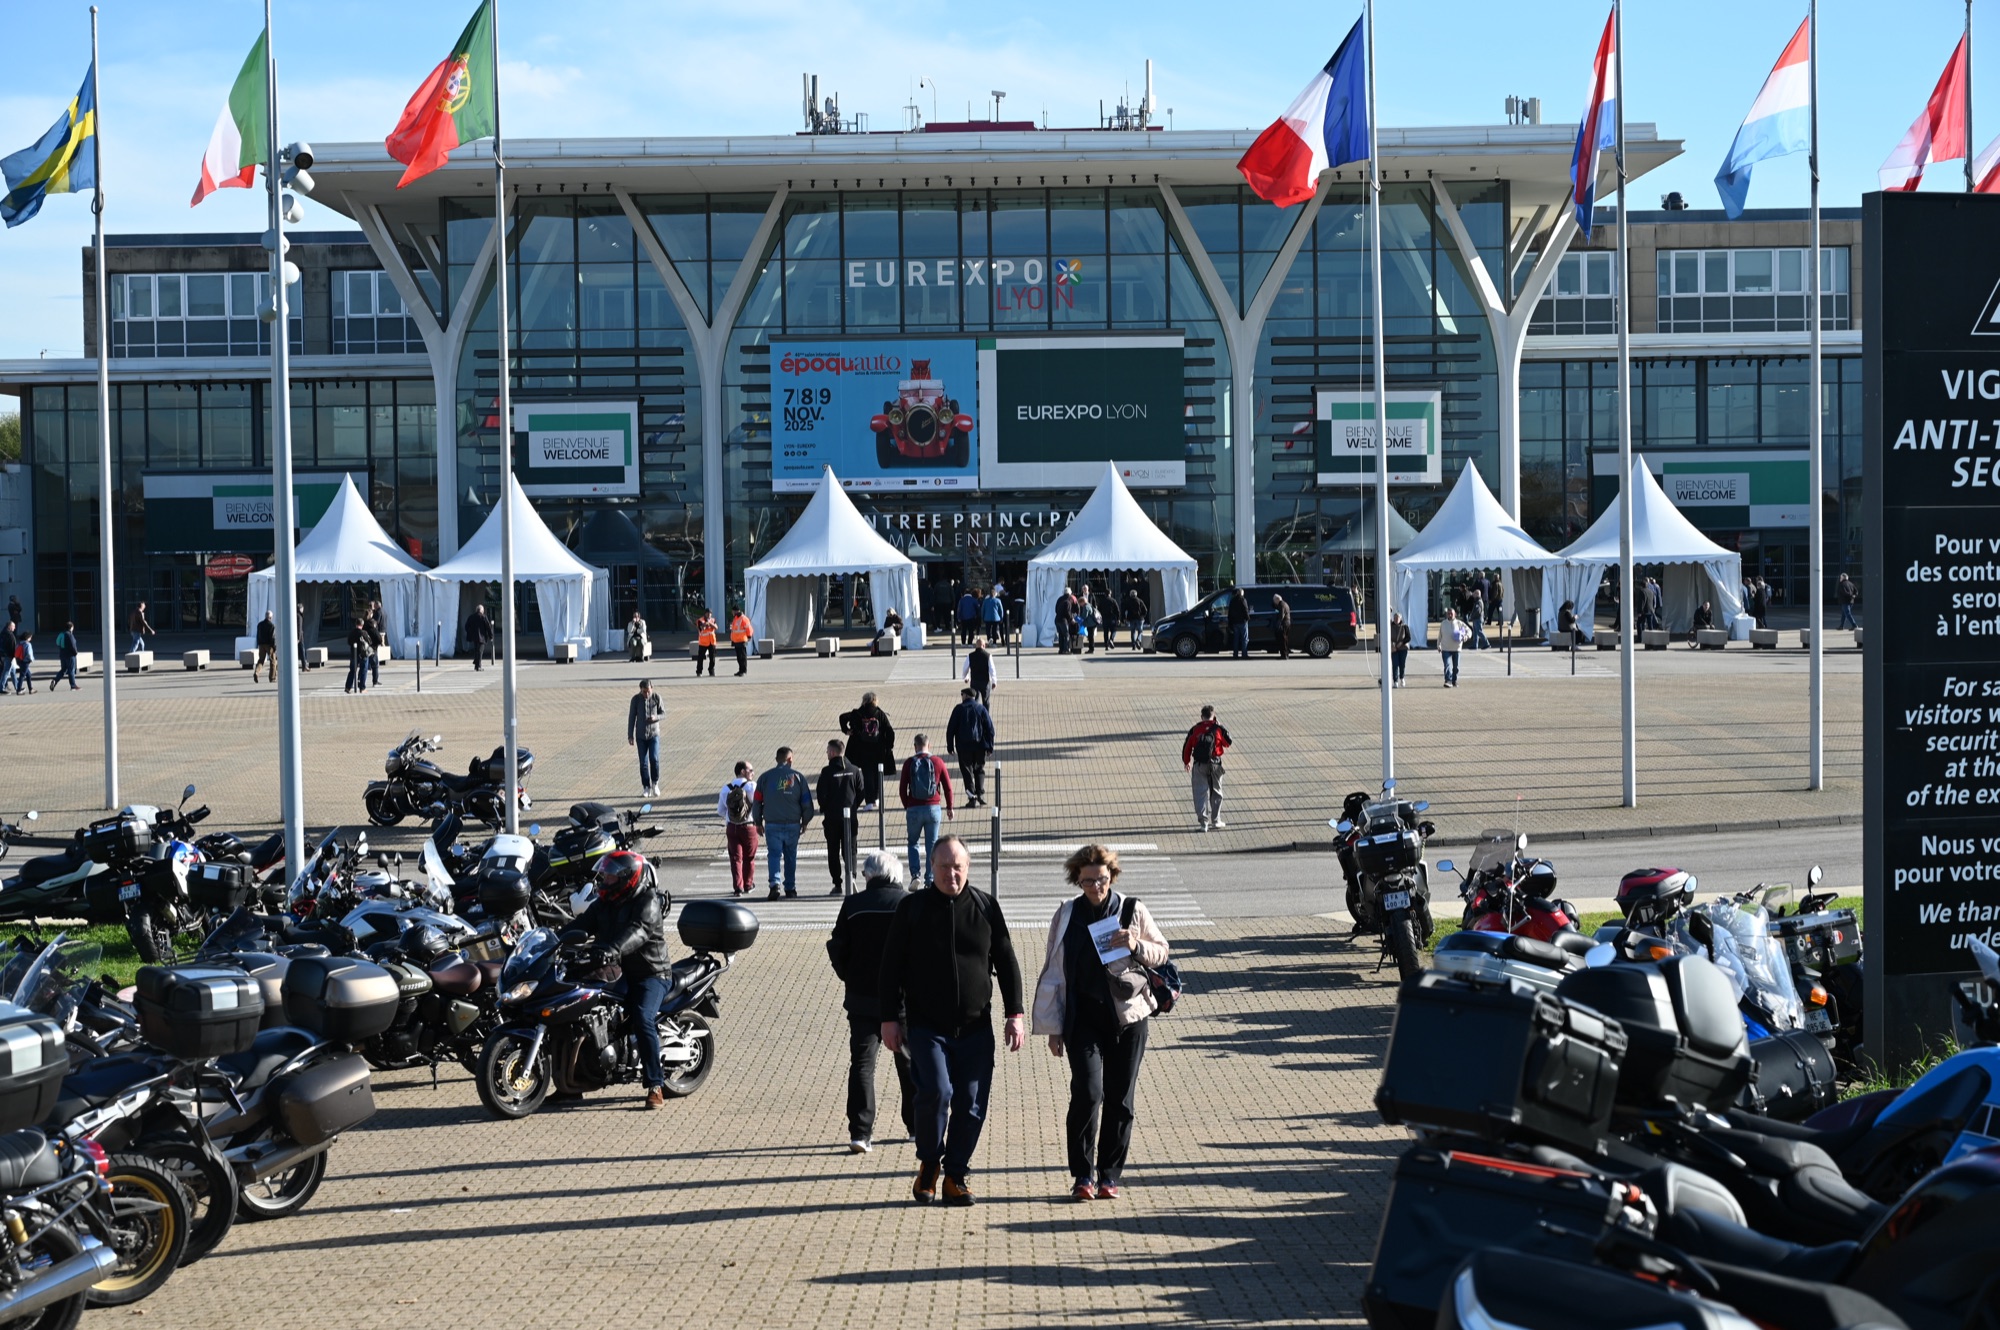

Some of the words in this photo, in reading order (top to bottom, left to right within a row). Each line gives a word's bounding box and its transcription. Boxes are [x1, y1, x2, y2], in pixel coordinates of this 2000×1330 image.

[849, 259, 1043, 288] EUREXPO
[997, 286, 1074, 311] LYON
[783, 406, 825, 421] NOV.
[1017, 404, 1102, 420] EUREXPO
[1106, 403, 1147, 419] LYON
[784, 420, 814, 431] 2025
[543, 437, 610, 449] BIENVENUE
[1346, 437, 1412, 449] WELOME
[544, 449, 610, 460] WELCOME
[1675, 479, 1737, 490] BIENVENUE
[1676, 489, 1736, 500] WELCOME
[1408, 511, 1416, 524] P
[888, 533, 943, 548] MAIN
[1935, 534, 1983, 554] Pour
[1906, 560, 1942, 582] des
[1937, 614, 1948, 636] à
[1943, 677, 1978, 697] For
[1905, 703, 1982, 725] visitors
[1945, 758, 1968, 778] at
[1906, 784, 1932, 806] of
[1935, 783, 1970, 806] the
[1922, 835, 1975, 856] Nous
[1895, 867, 1944, 891] pour
[1920, 903, 1952, 924] We
